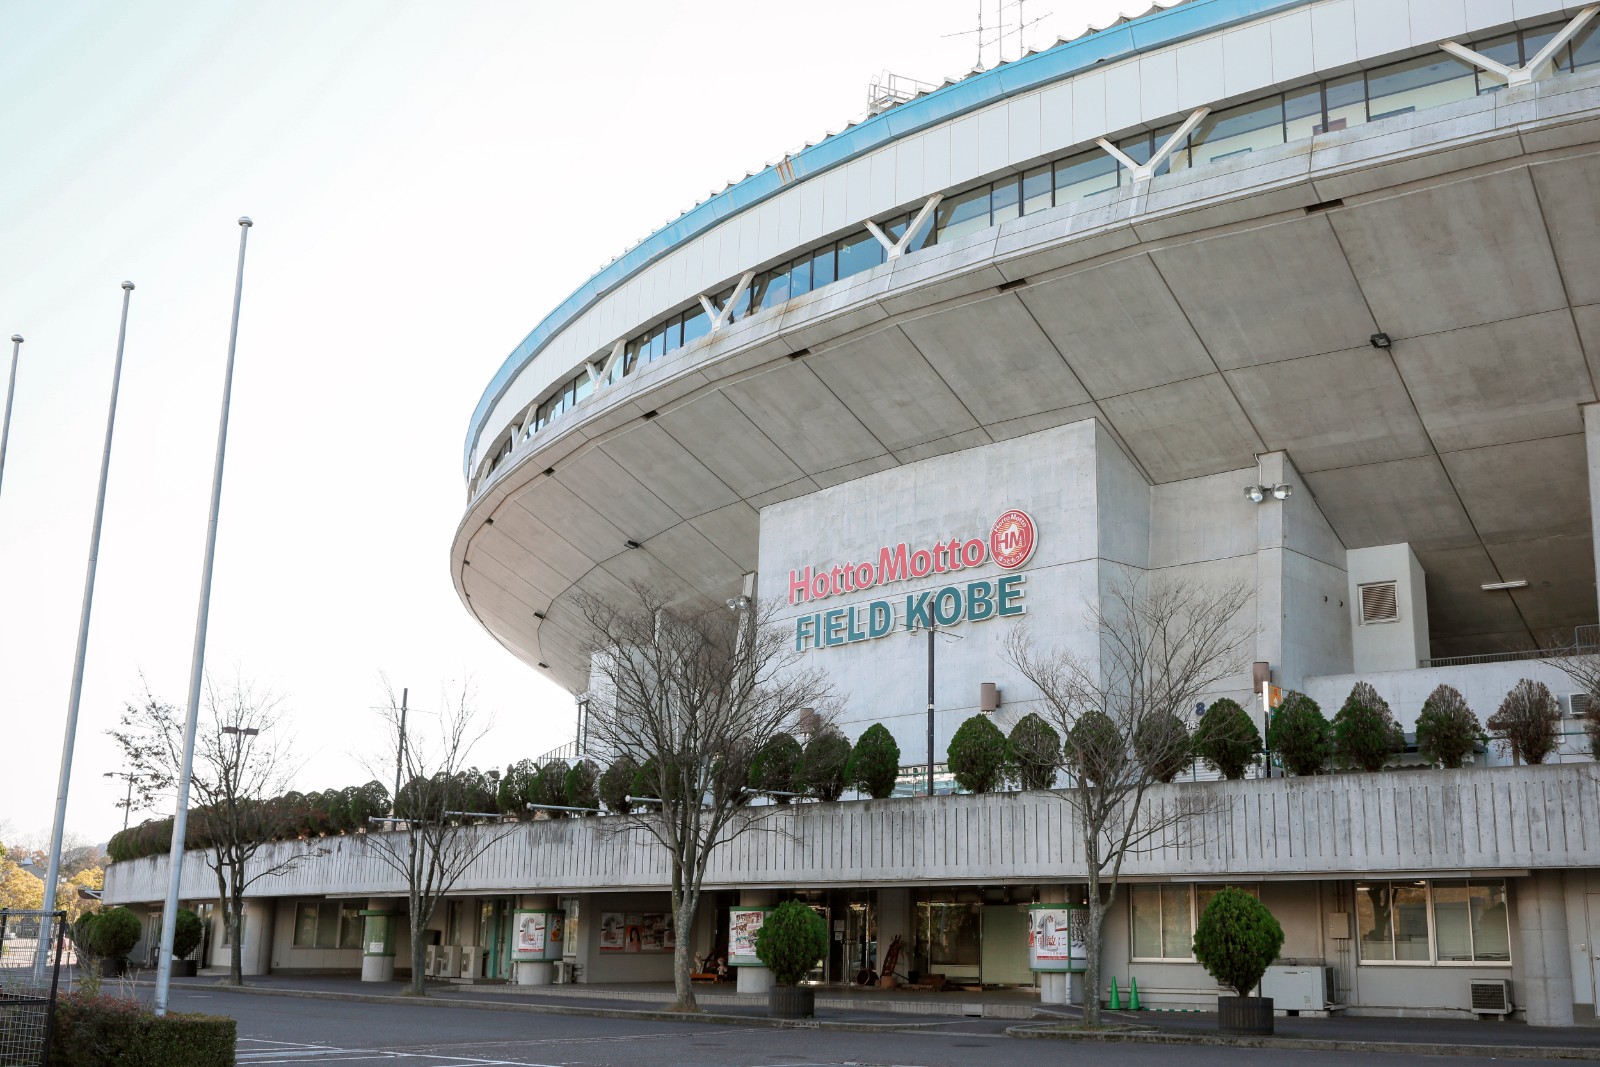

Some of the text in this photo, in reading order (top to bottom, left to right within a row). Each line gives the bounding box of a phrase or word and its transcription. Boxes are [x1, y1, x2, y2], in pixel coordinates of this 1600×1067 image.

[995, 529, 1026, 552] HM
[788, 537, 986, 605] HottoMotto
[795, 574, 1025, 652] FIELD KOBE
[1195, 702, 1206, 717] 8
